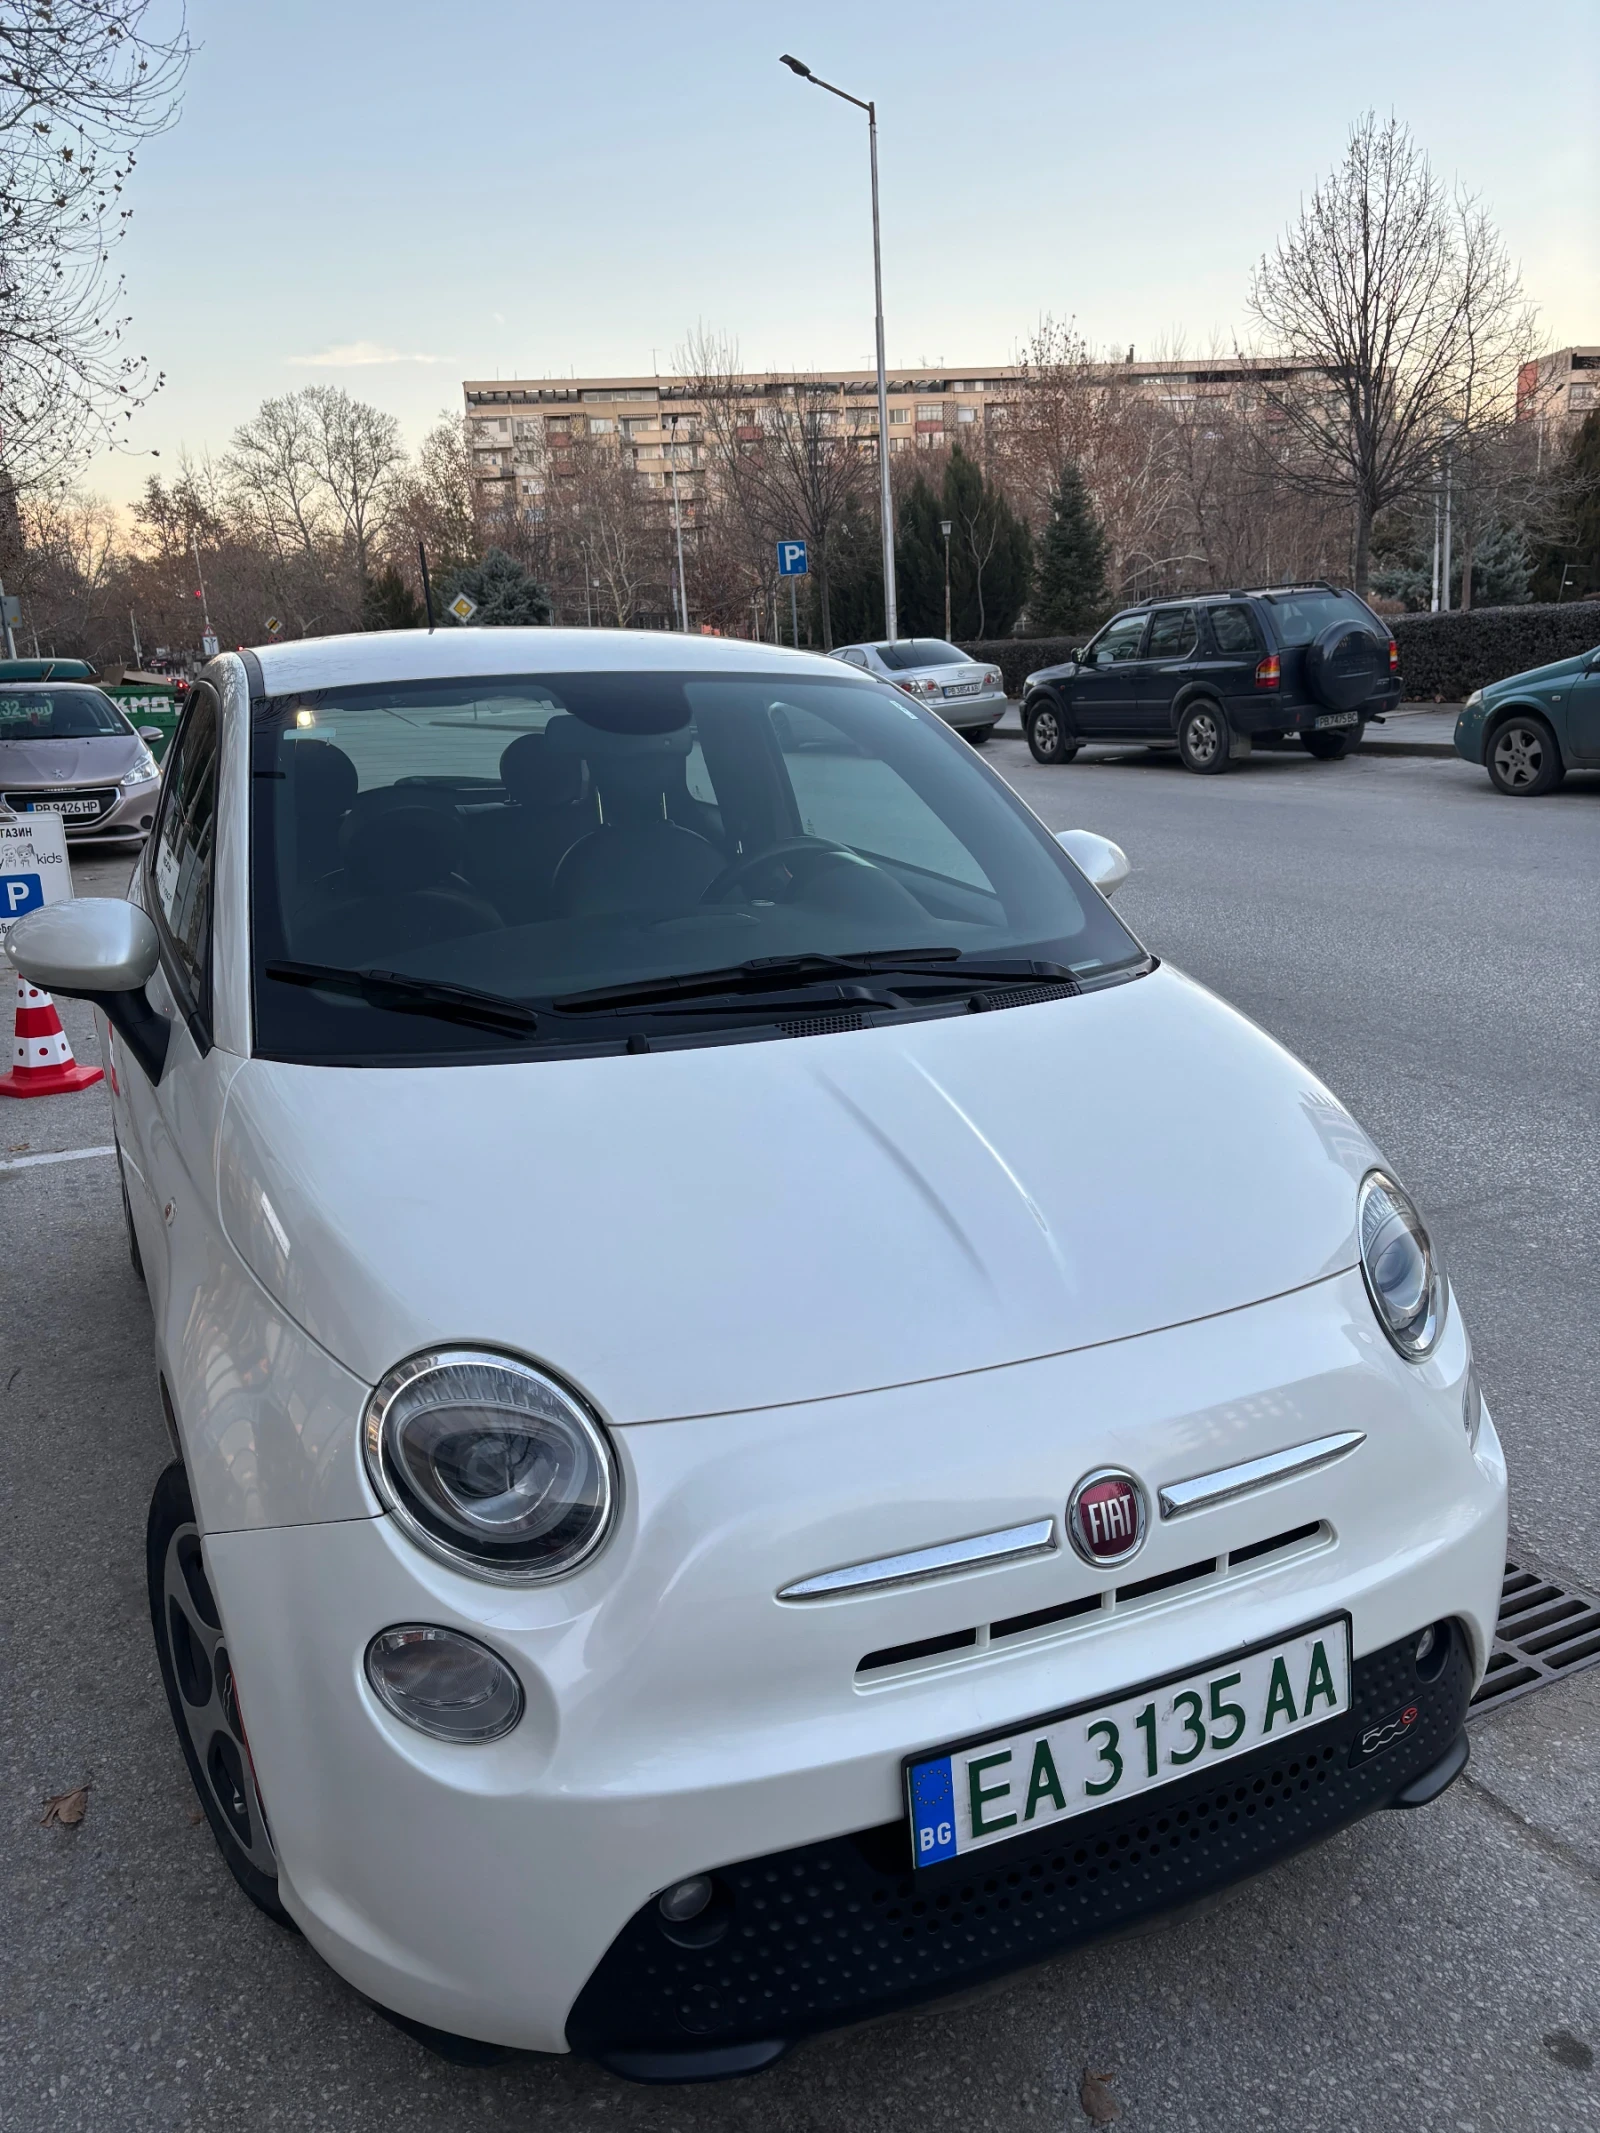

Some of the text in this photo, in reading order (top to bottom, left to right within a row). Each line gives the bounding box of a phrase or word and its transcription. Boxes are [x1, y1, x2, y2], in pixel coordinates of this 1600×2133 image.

[53, 802, 81, 814] 9426
[82, 801, 98, 813] HP
[36, 852, 63, 865] kids
[7, 882, 30, 911] P
[1088, 1494, 1132, 1544] FIAT
[966, 1638, 1338, 1838] EA 3135 AA
[919, 1822, 952, 1852] BG
